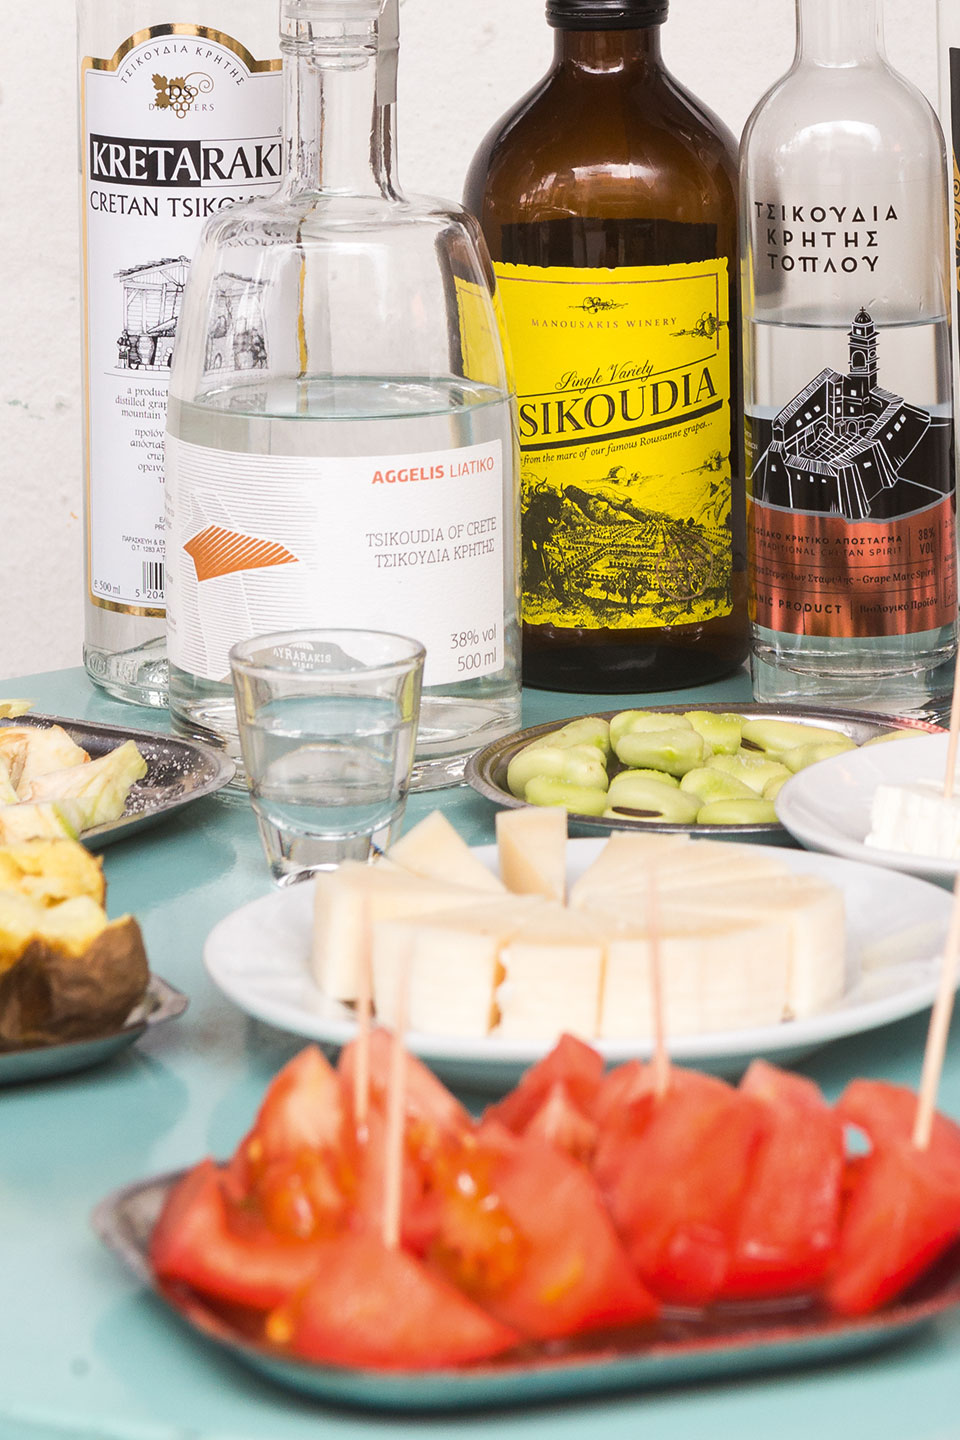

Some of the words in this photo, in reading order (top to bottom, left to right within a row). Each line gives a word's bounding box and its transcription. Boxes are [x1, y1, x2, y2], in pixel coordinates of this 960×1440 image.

[120, 44, 188, 84] ΤΣΙΚΟΥΔΙΑ
[195, 47, 245, 86] ΚΡΗΤΗΣ
[90, 190, 158, 216] CRETAN
[754, 201, 898, 222] ΤΣΙΚΟΥΔΙΑ
[767, 228, 878, 248] ΚΡΗΤΗΣ
[767, 254, 879, 273] ΤΟΠΛΟΥ
[531, 318, 618, 329] MANOUSAKIS
[626, 317, 678, 328] WINERY
[555, 371, 603, 394] Single
[607, 360, 654, 382] Variety
[115, 395, 145, 407] distilled
[135, 387, 169, 397] product
[520, 367, 717, 438] SIKOUDIA
[121, 409, 161, 419] mountain
[523, 455, 540, 467] from
[543, 452, 555, 463] the
[556, 450, 577, 461] marc
[579, 447, 590, 463] of
[591, 445, 605, 456] our
[606, 441, 638, 456] famous
[640, 429, 682, 447] Roussanne
[372, 465, 444, 484] AGGELIS
[450, 456, 494, 478] LIATIKO
[366, 528, 444, 547] TSIKOUDIA
[448, 525, 464, 539] OF
[467, 517, 496, 536] CRETE
[375, 549, 450, 568] ΤΣΙΚΟΥΔΙΑ
[453, 538, 494, 560] ΚΡΗΤΗΣ
[779, 599, 842, 614] PRODUCT
[450, 628, 479, 649] 38%
[482, 623, 496, 642] vol
[457, 653, 481, 672] 500
[484, 649, 496, 666] ml
